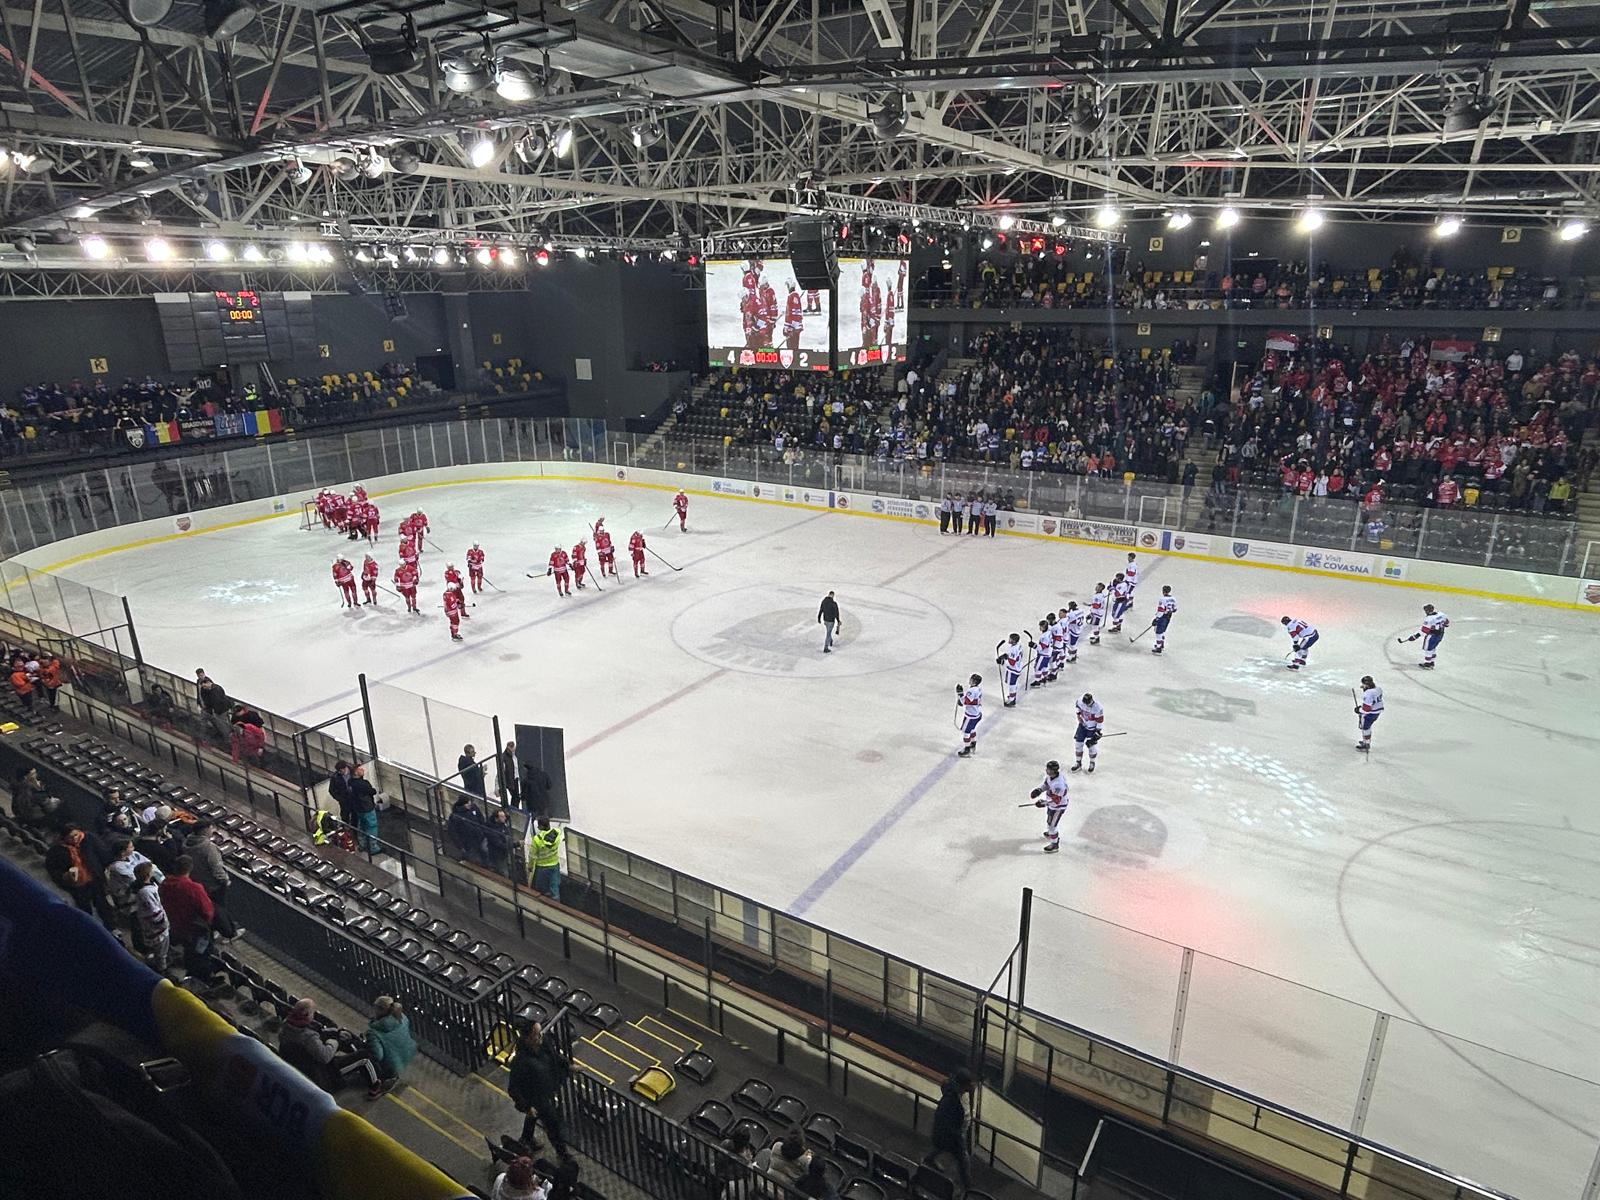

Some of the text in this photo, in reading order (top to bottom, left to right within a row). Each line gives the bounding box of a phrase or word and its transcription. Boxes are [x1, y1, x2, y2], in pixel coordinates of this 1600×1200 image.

[226, 297, 233, 305] 4
[236, 297, 243, 306] 3
[251, 297, 258, 306] 2
[229, 310, 253, 320] 00:00
[727, 350, 736, 364] 4
[755, 352, 779, 363] 00:00
[891, 346, 897, 360] 2
[94, 359, 105, 371] K
[799, 352, 809, 367] 2
[1325, 553, 1342, 563] Visit
[1322, 562, 1370, 575] COVASNA
